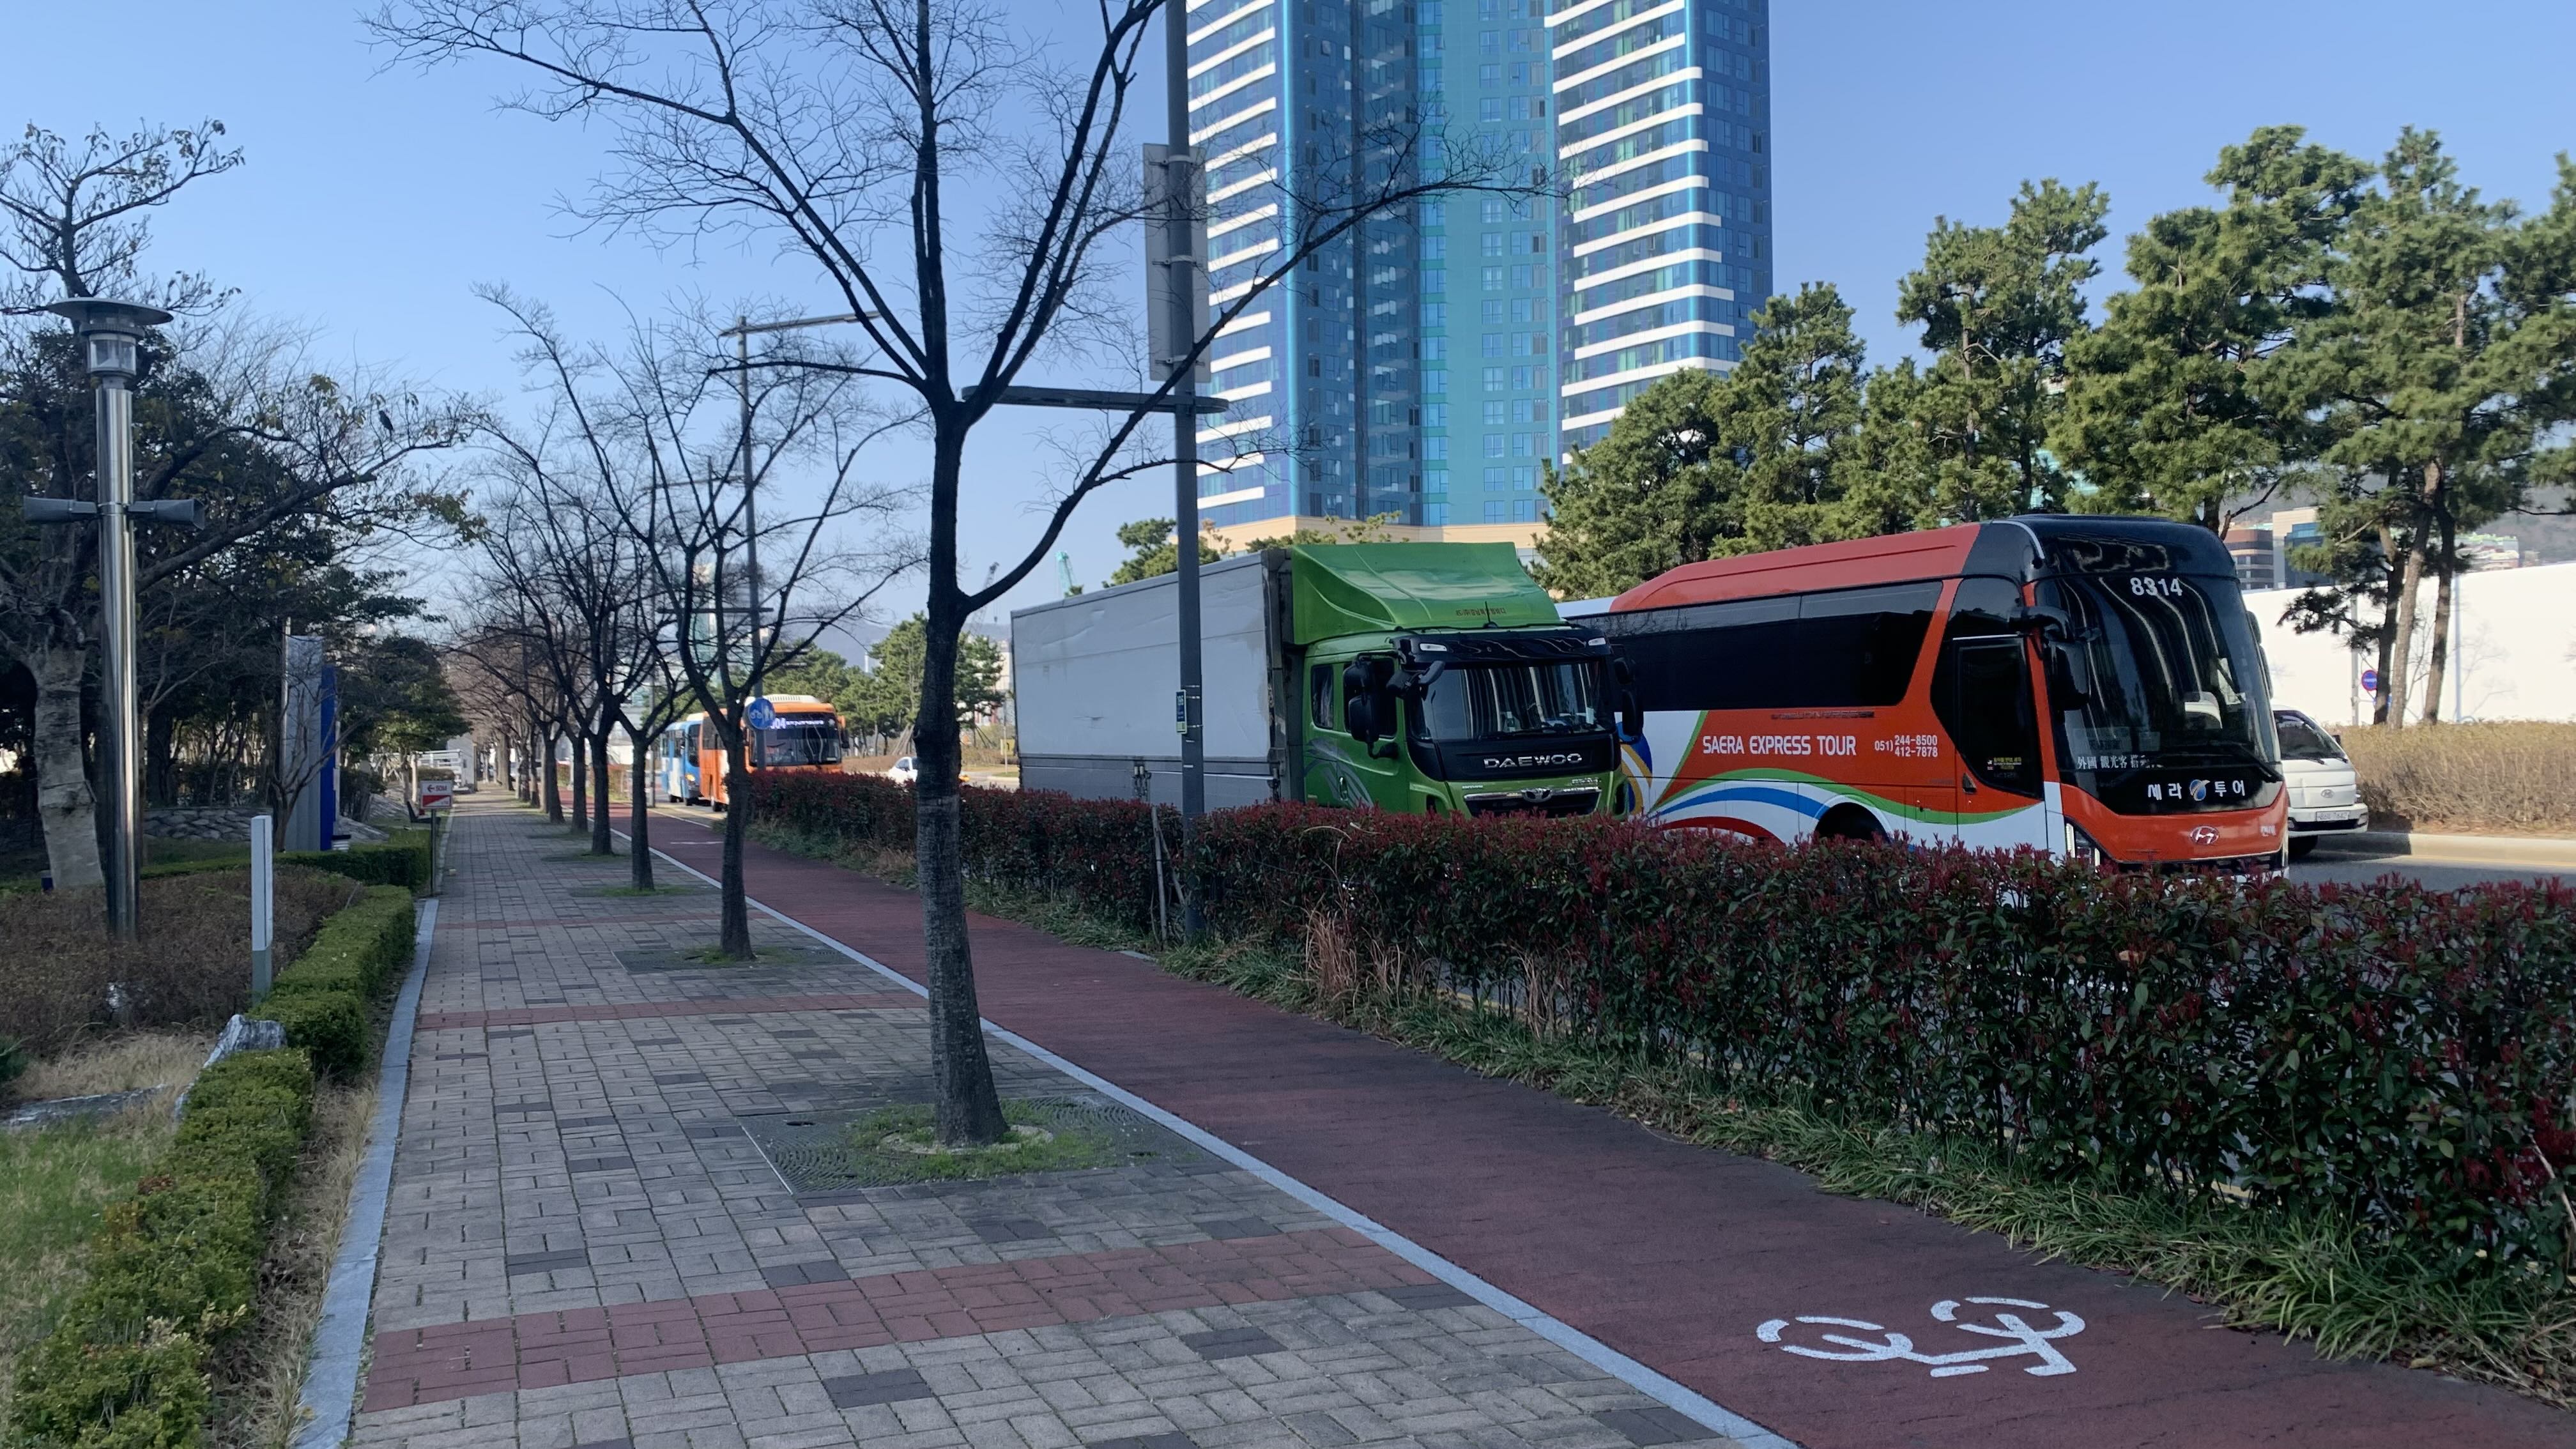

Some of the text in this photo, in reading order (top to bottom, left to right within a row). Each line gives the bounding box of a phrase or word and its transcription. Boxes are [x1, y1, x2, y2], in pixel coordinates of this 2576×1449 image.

[2130, 577, 2183, 596] 8314
[1703, 735, 1893, 756] SAERA EXPRESS TOUR 051)
[1894, 735, 1938, 746] 244-8500
[1895, 746, 1938, 757] 412-7878
[1483, 753, 1583, 769] DAEWOO
